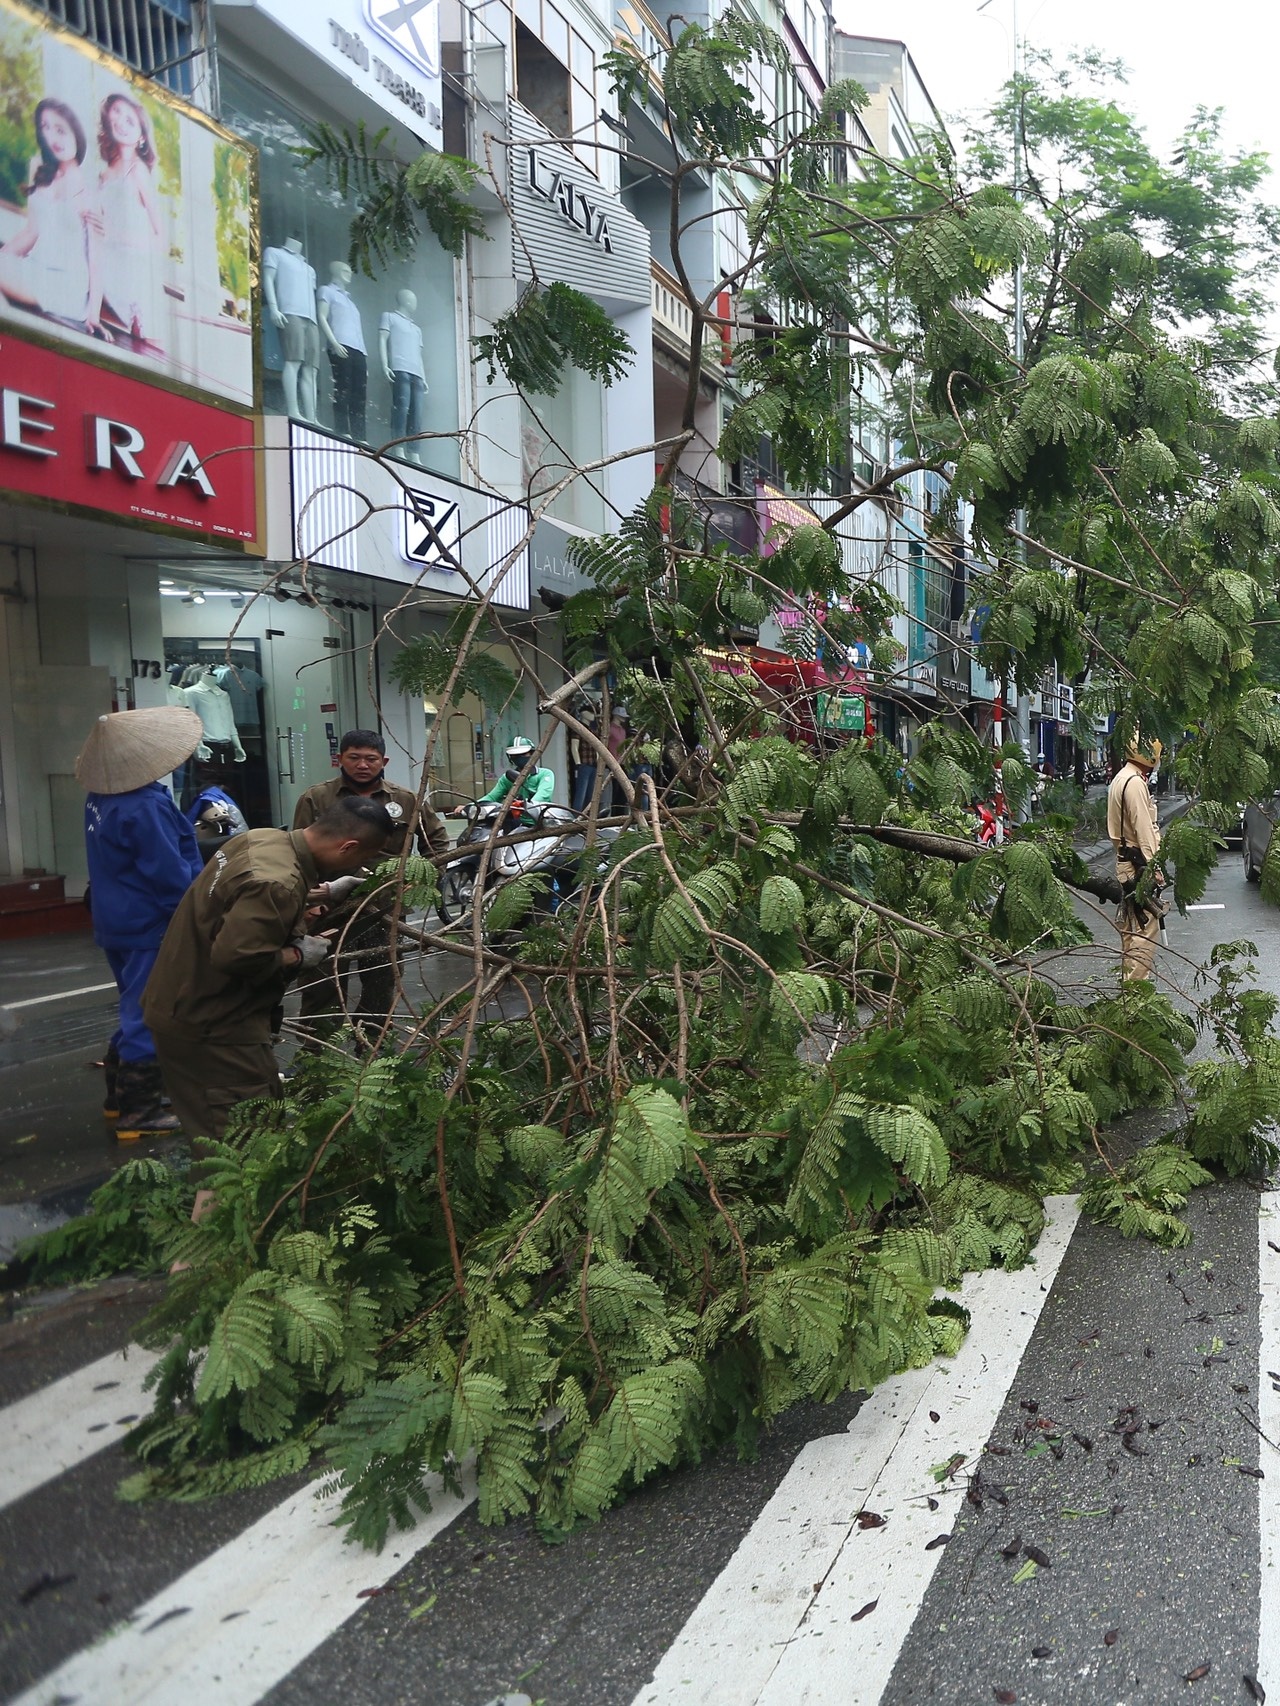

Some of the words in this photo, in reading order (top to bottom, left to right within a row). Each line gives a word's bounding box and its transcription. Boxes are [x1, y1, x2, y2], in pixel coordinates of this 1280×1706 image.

[527, 149, 614, 255] LALYA
[2, 387, 217, 498] ERA
[534, 551, 576, 580] LALYA
[131, 658, 162, 679] 173
